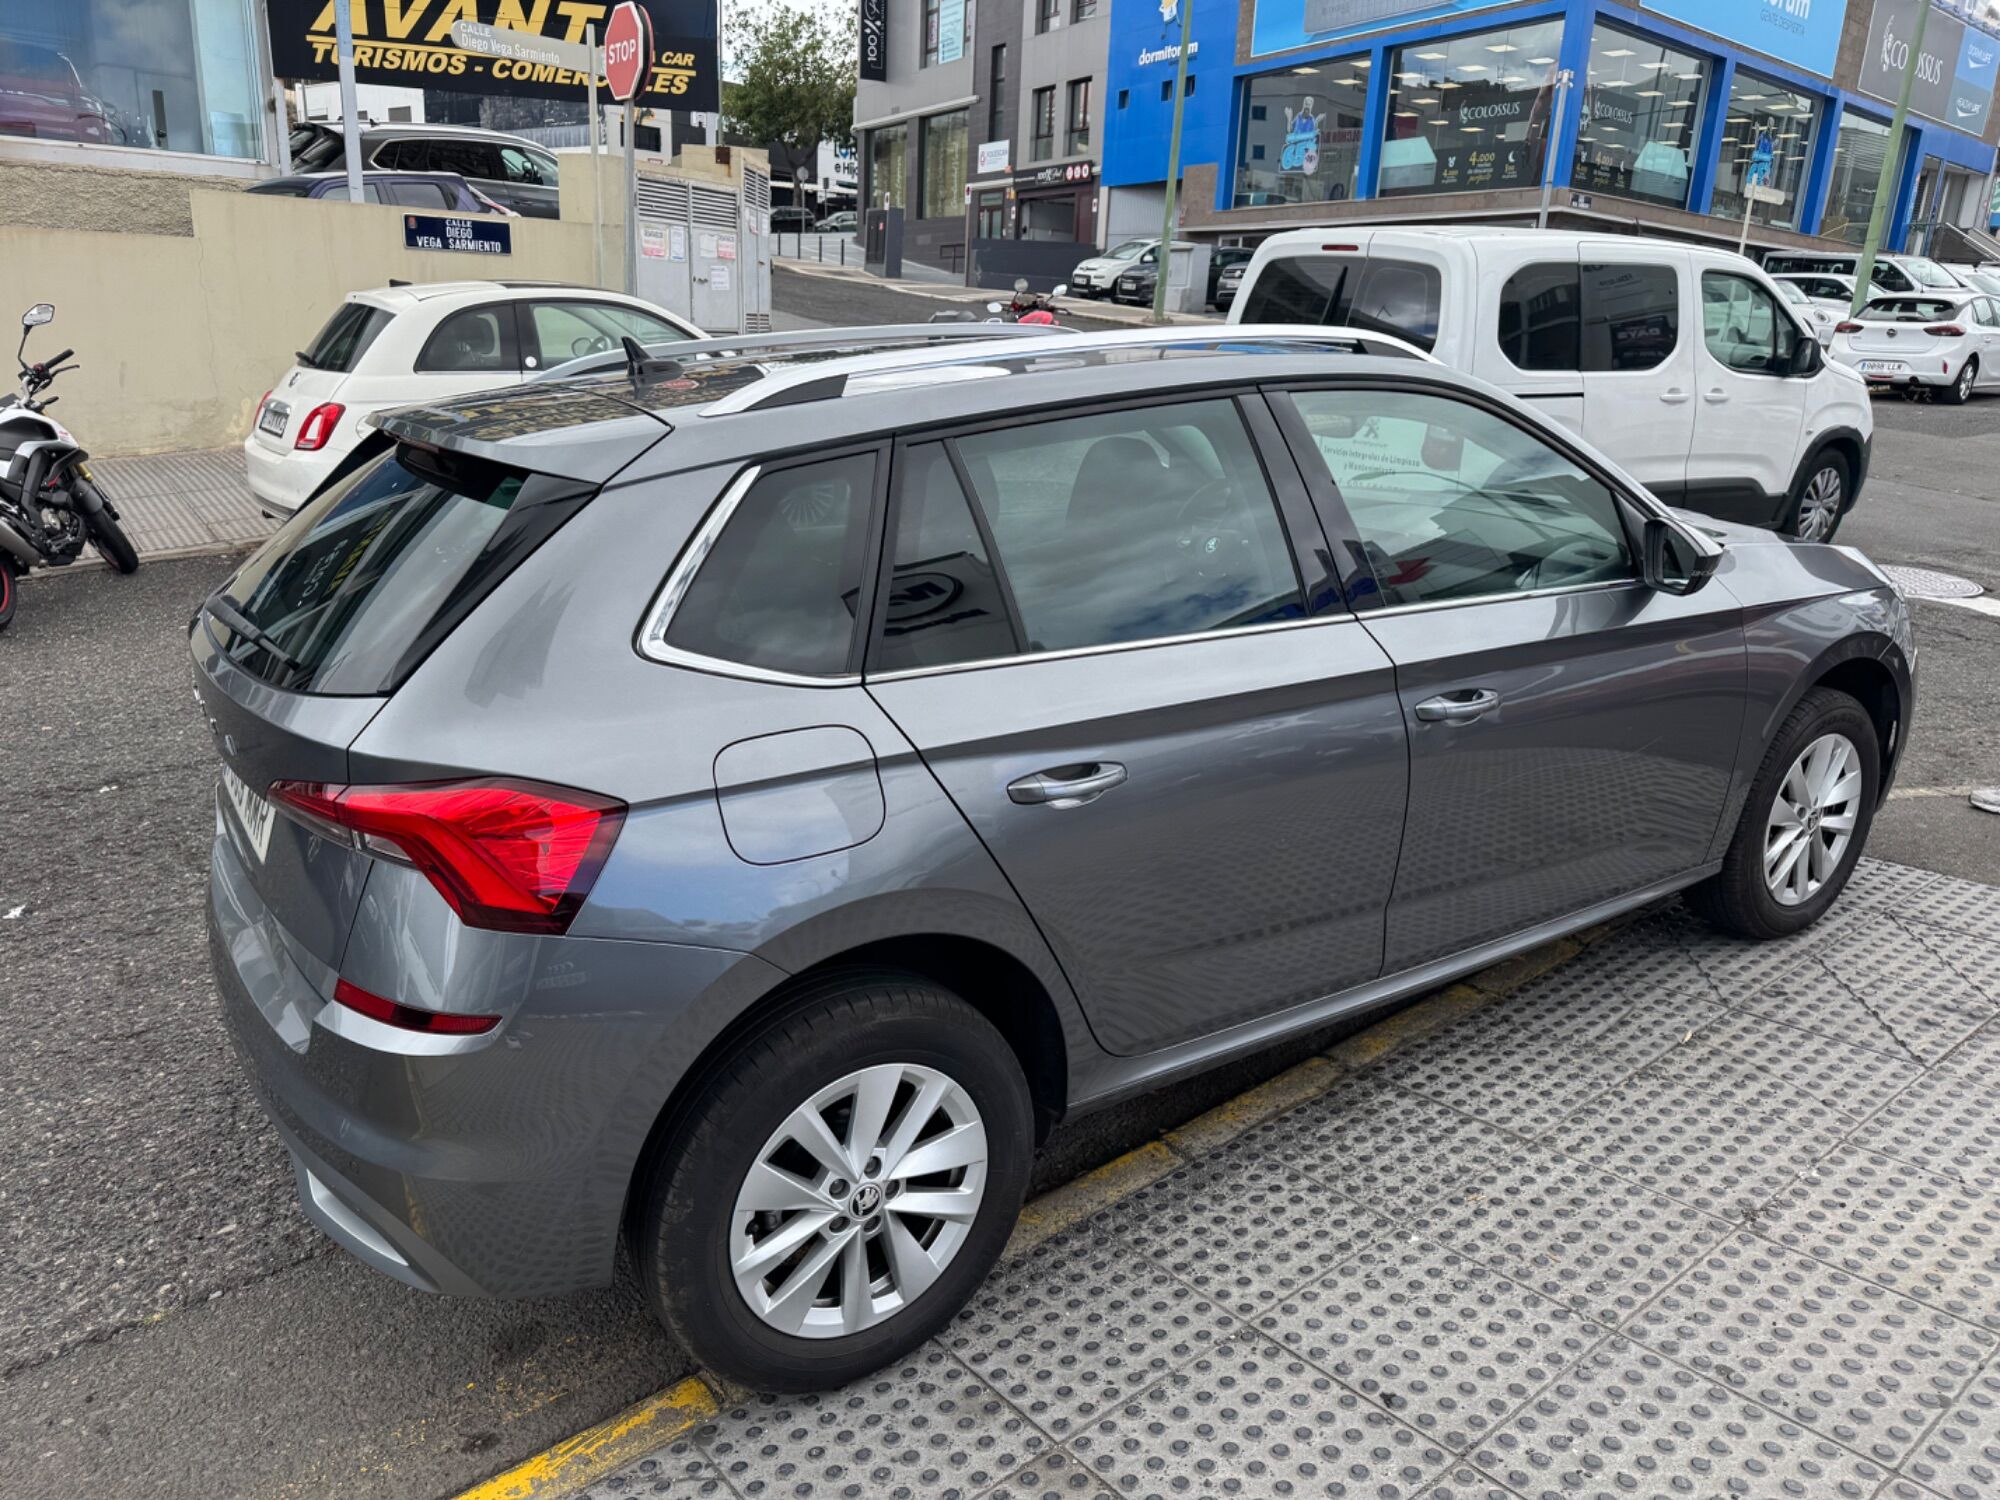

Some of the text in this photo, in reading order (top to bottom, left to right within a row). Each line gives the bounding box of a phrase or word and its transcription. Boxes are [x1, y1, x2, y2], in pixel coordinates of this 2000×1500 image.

[460, 23, 491, 38] CALLE
[461, 33, 560, 64] Diego Vega Sarmiento
[608, 39, 636, 65] STOP
[1138, 41, 1199, 66] dormitorm
[661, 51, 697, 67] CAR
[1890, 40, 1944, 85] COSSUS
[1467, 101, 1520, 120] COLOSSUS
[445, 219, 473, 228] CALLE
[446, 226, 473, 239] DIEGO
[416, 235, 502, 253] VEGA SARMIENTO
